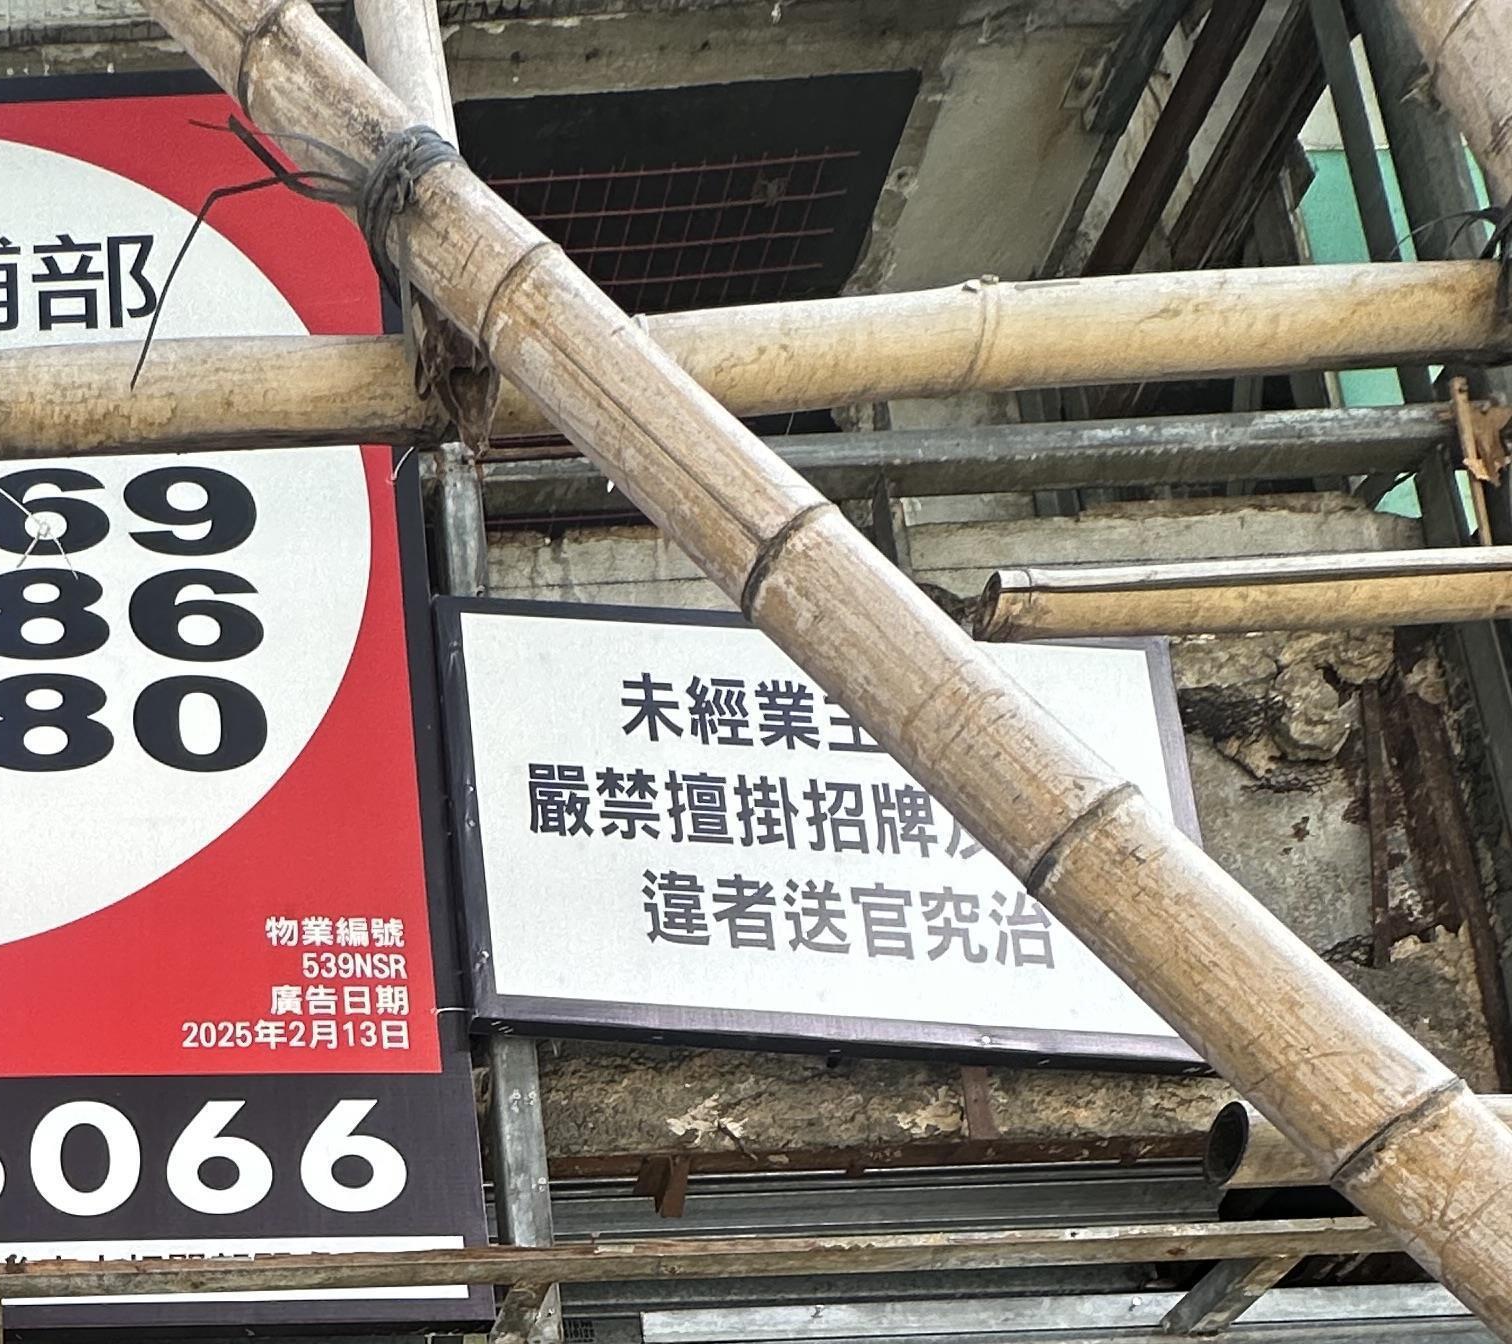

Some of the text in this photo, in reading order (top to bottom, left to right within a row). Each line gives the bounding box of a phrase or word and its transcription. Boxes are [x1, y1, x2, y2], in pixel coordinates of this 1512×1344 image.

[529, 763, 988, 860] 嚴禁擅掛招牌
[264, 916, 404, 948] 物業編號
[642, 869, 1057, 970] 違者送官究治
[302, 952, 407, 979] 539NSR
[270, 983, 409, 1017] 廣告日期
[180, 1018, 410, 1051] 2025年2月13日
